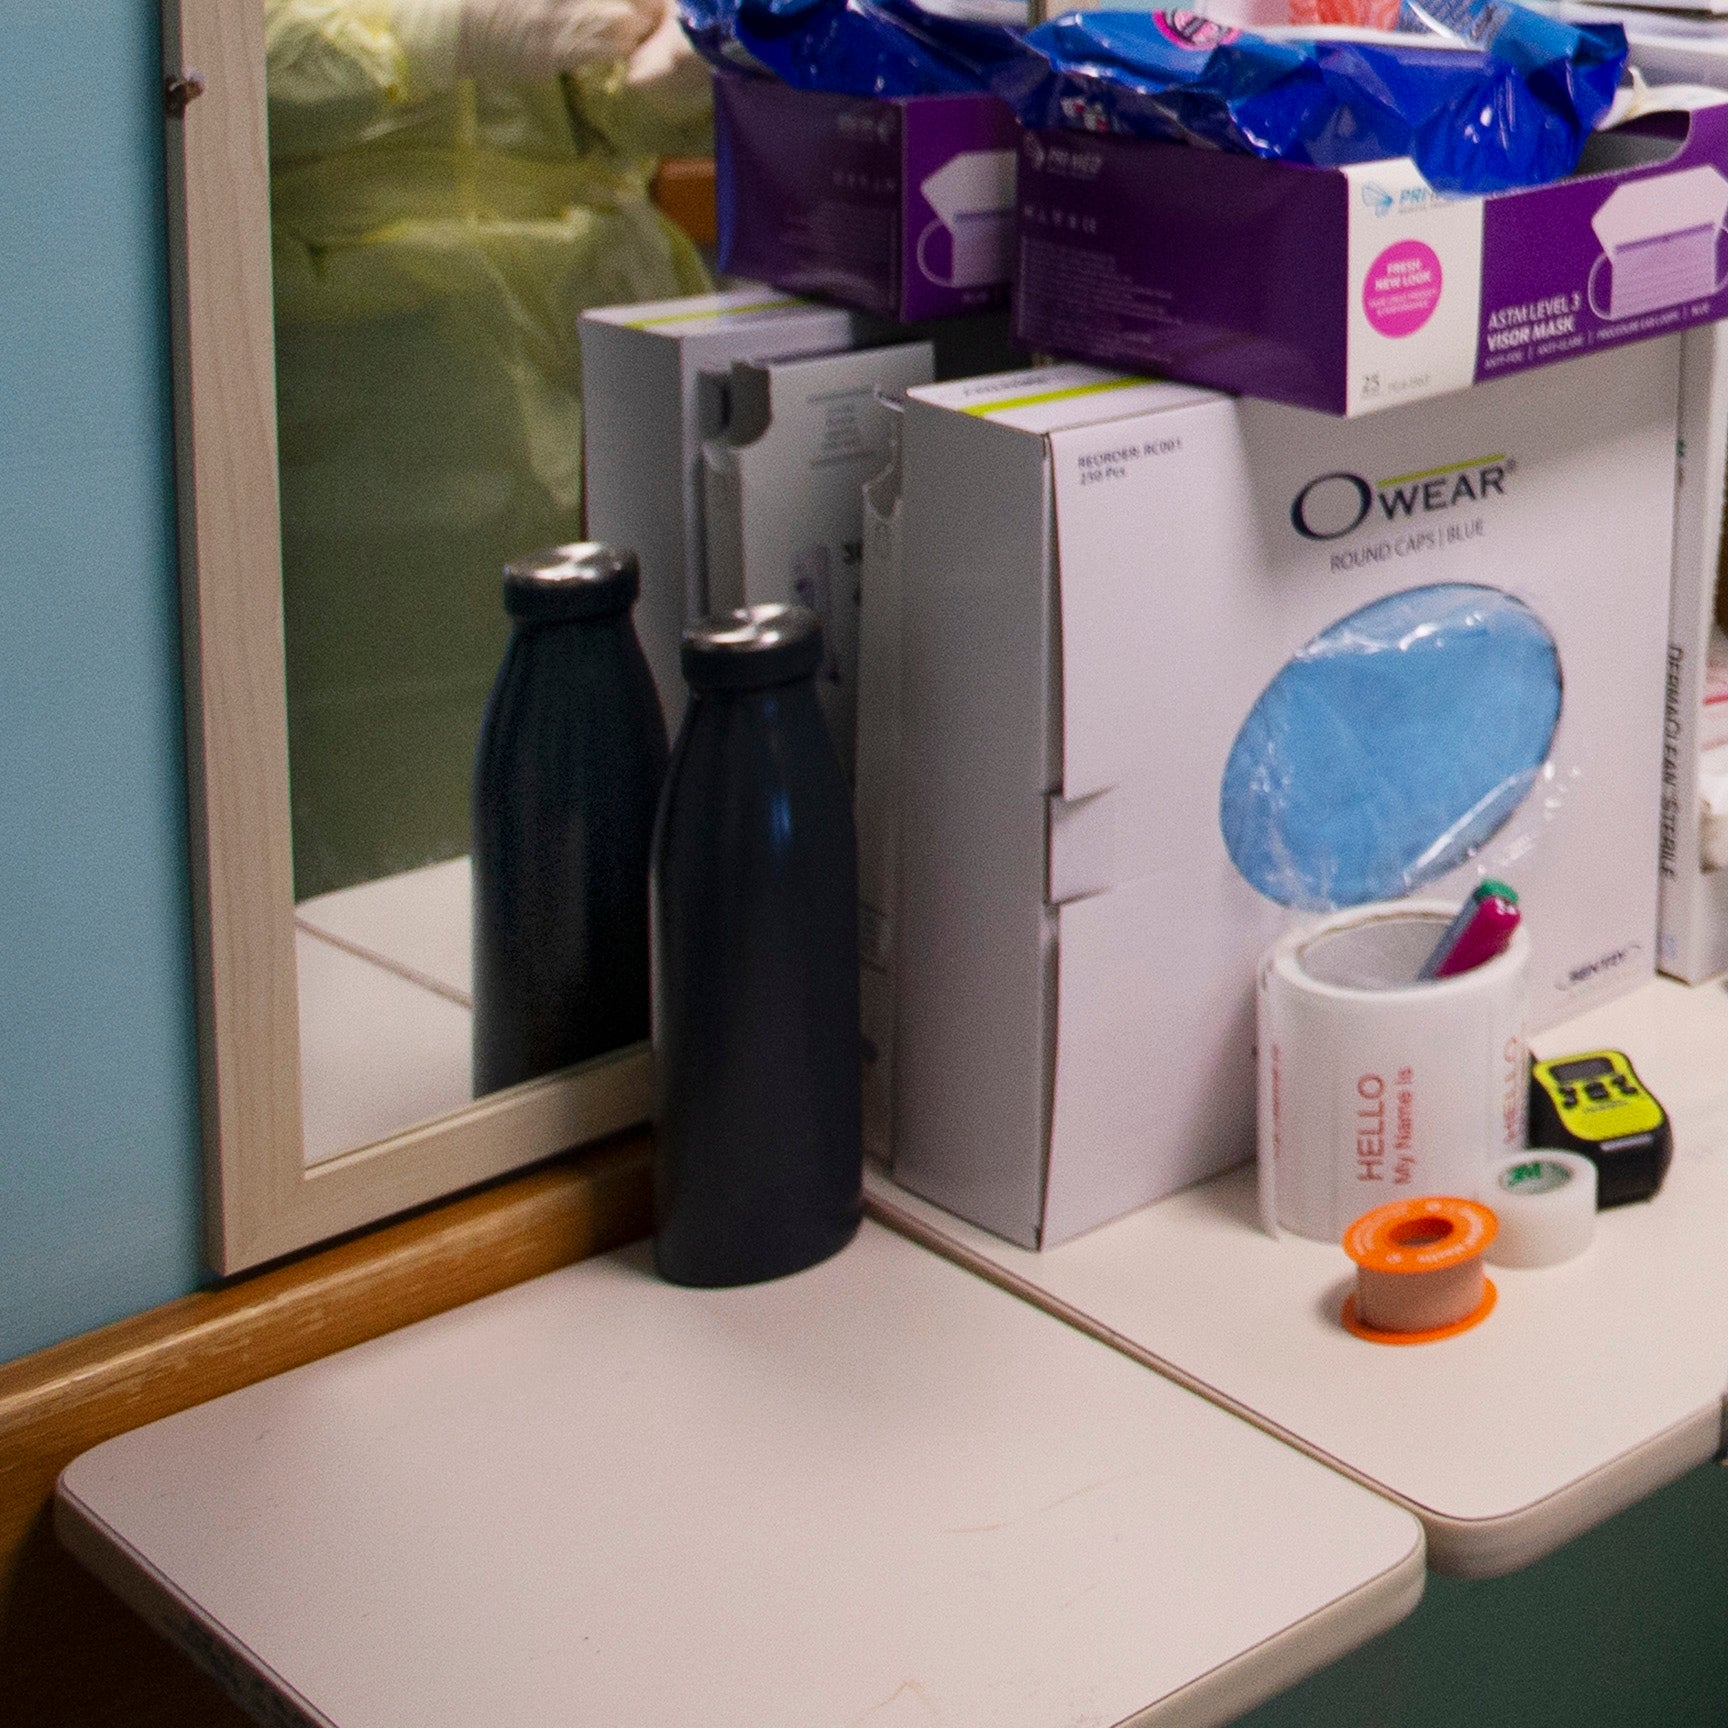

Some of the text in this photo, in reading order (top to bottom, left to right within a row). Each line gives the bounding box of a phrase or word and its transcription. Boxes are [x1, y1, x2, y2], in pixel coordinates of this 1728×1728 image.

[1487, 315, 1576, 353] VISOR MASK
[1488, 290, 1582, 331] ASTM LEVEL 3
[1329, 517, 1484, 571] ROUND CAPS BLUE
[1357, 1073, 1385, 1182] HELLO
[1394, 1091, 1413, 1150] Name
[1394, 1156, 1416, 1185] My
